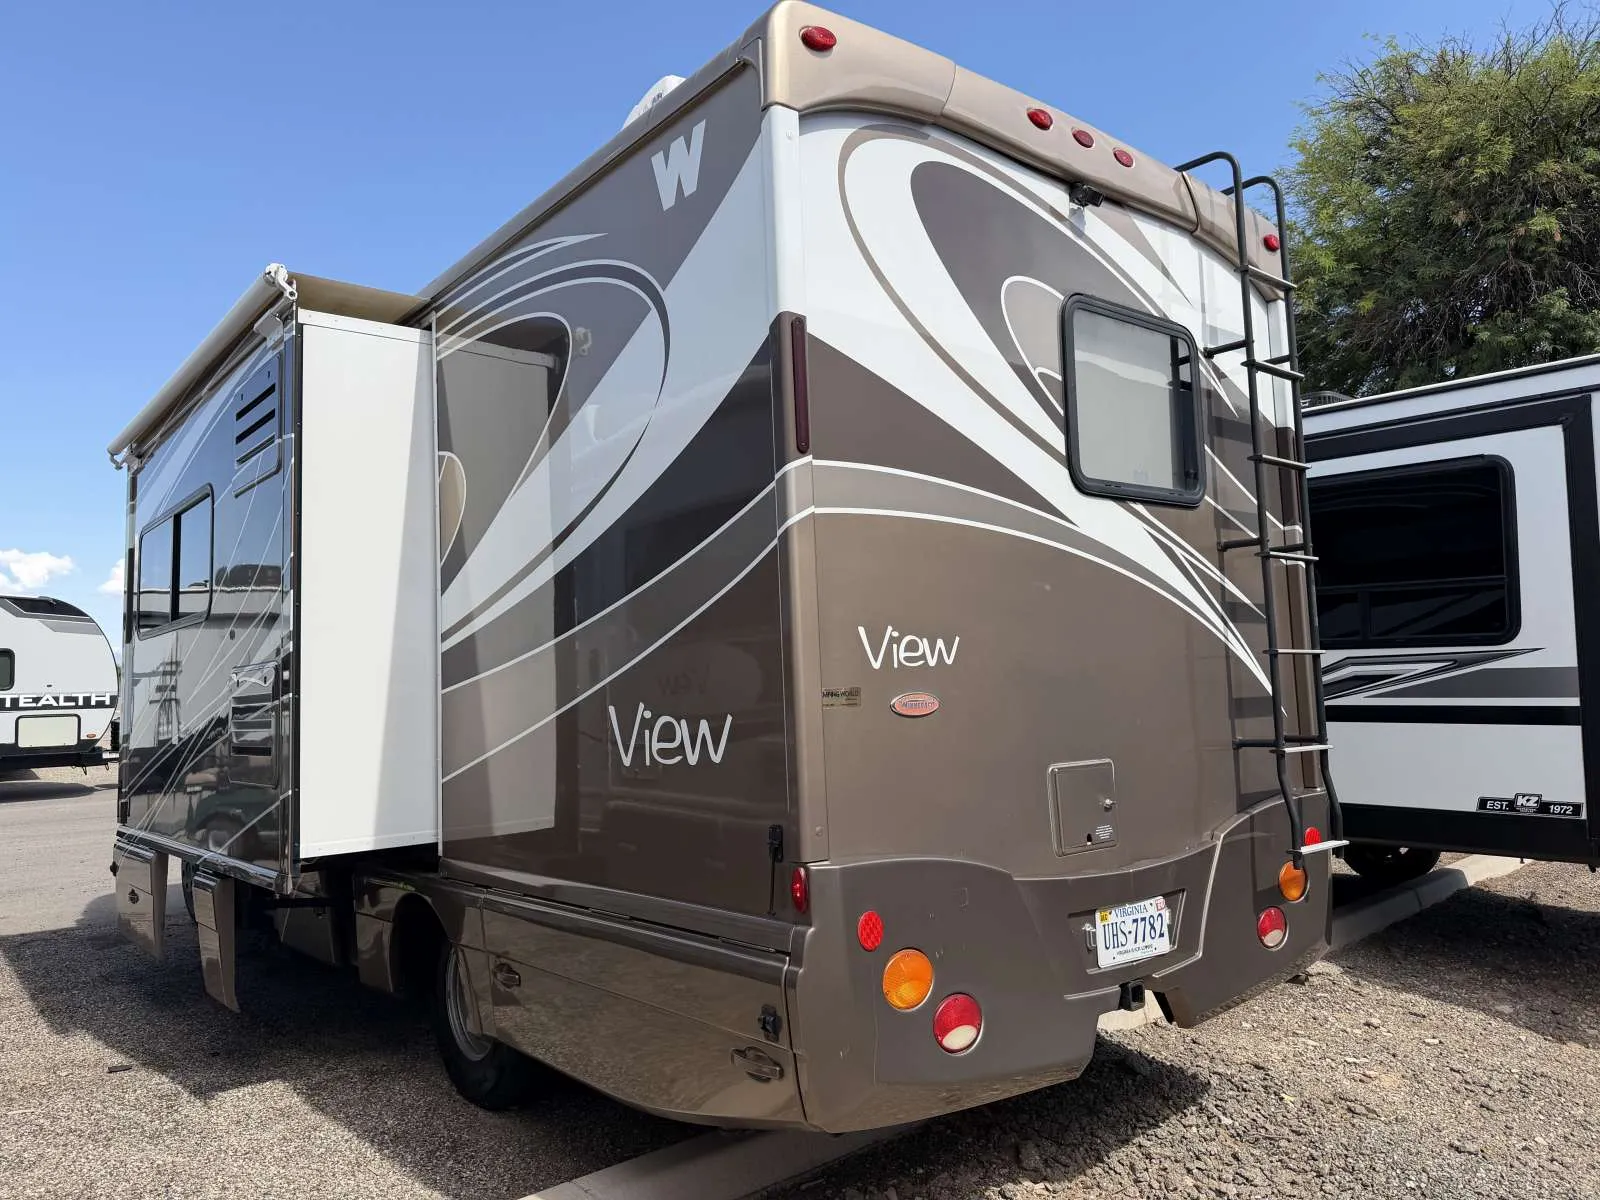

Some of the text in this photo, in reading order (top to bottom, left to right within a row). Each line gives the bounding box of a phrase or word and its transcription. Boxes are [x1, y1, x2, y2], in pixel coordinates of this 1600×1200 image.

[858, 625, 960, 669] View
[609, 702, 732, 767] View
[1486, 800, 1509, 811] EST.
[1549, 804, 1573, 815] 1972
[1516, 795, 1540, 807] KZ
[1114, 903, 1149, 919] VIRGINIA
